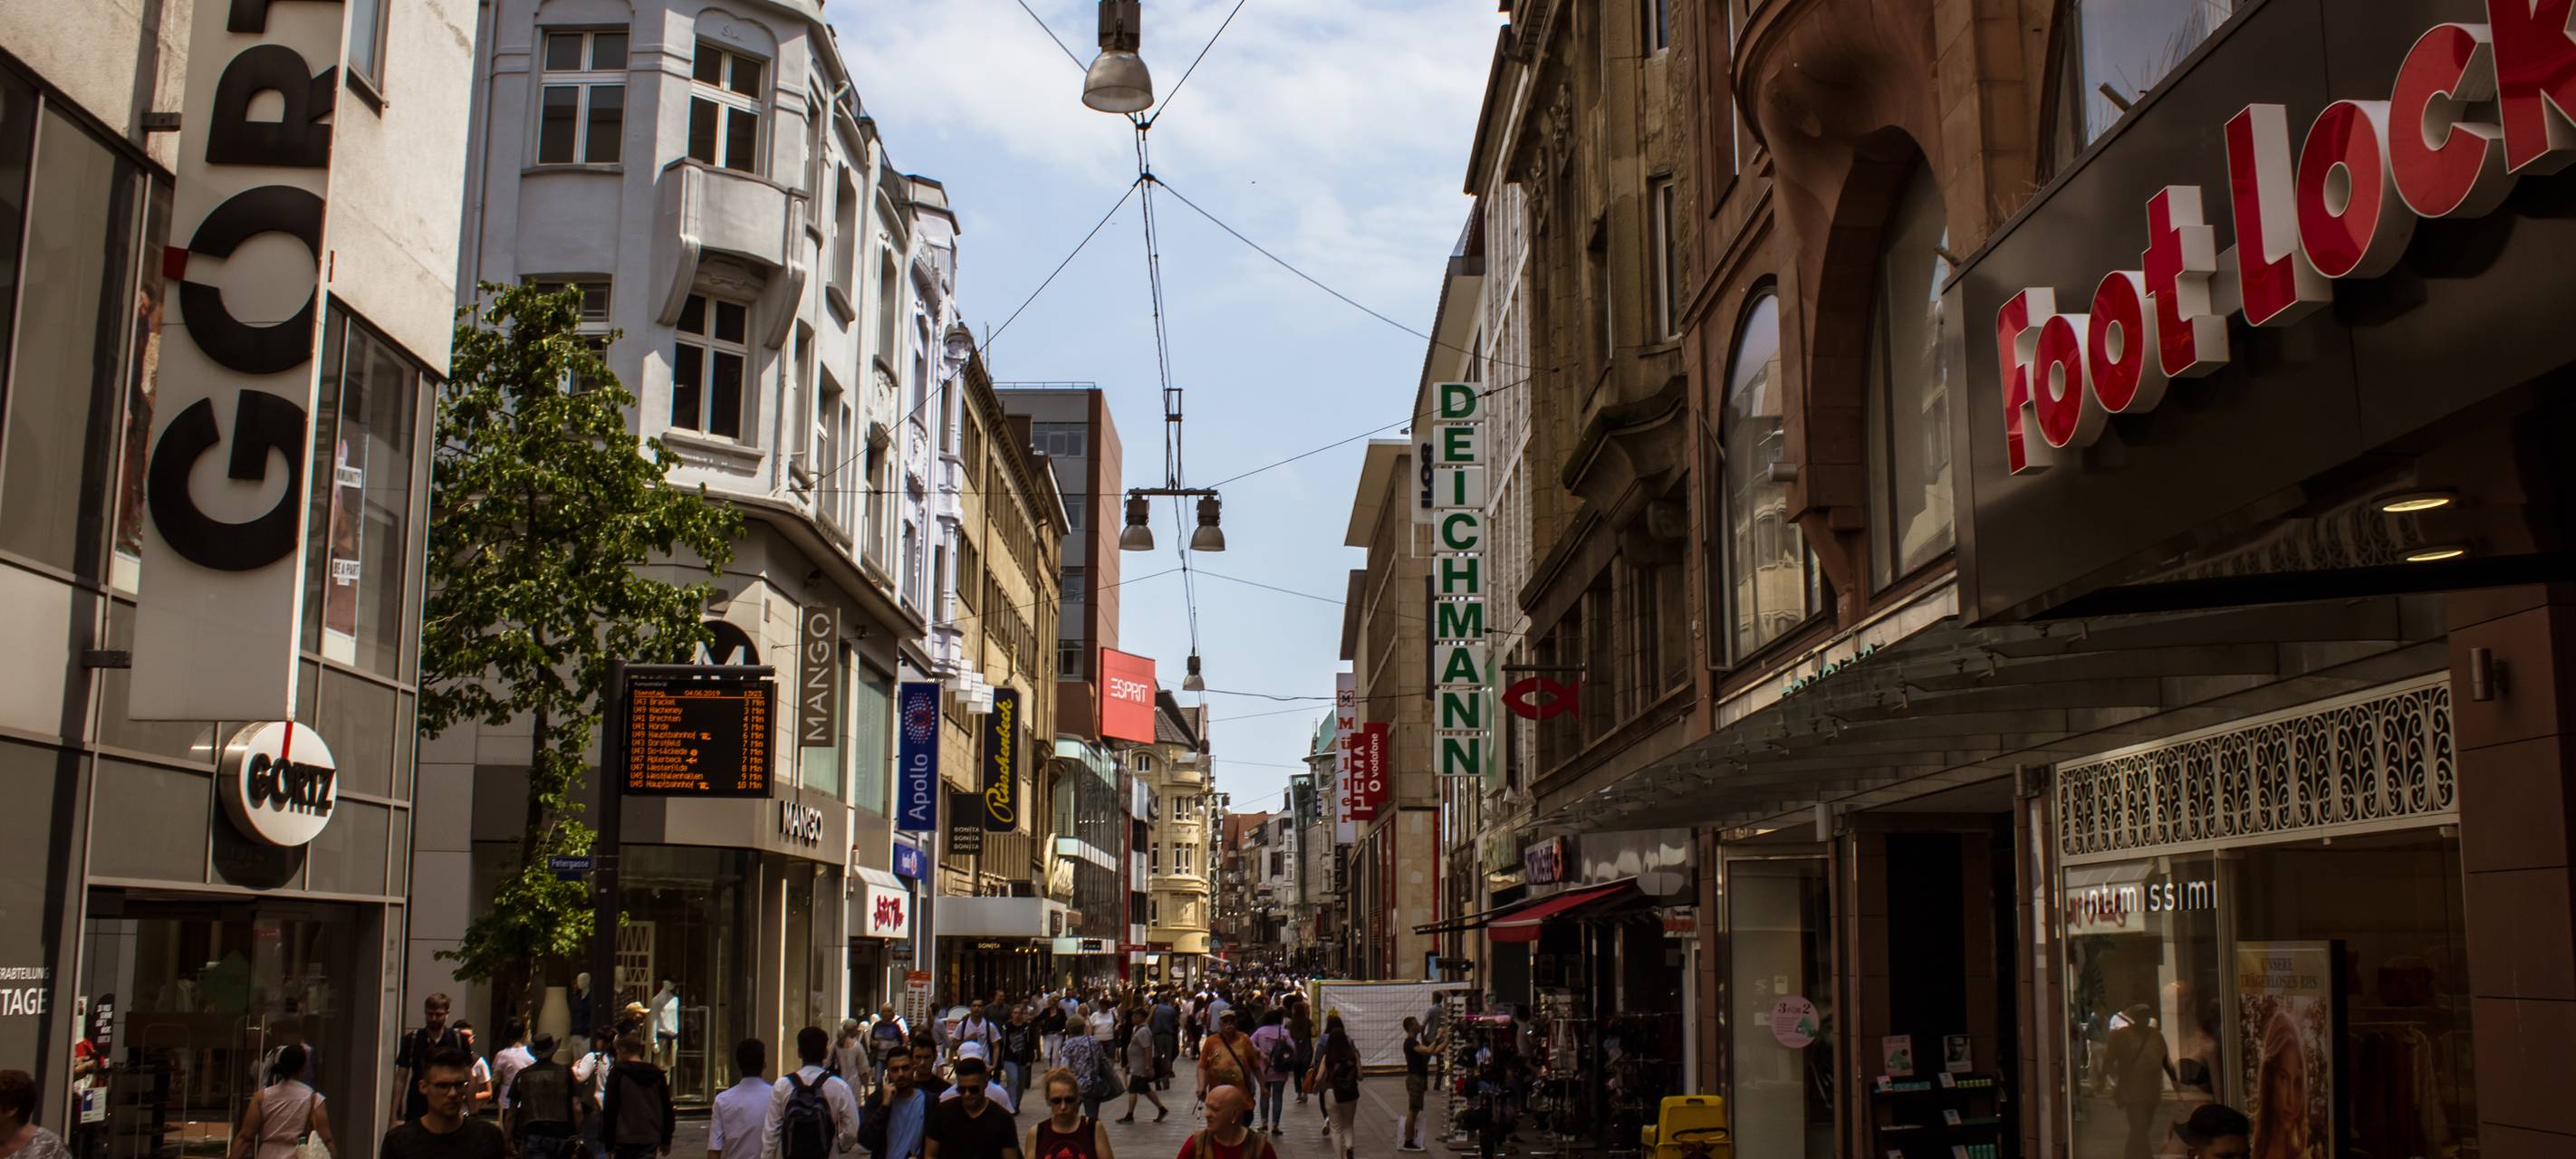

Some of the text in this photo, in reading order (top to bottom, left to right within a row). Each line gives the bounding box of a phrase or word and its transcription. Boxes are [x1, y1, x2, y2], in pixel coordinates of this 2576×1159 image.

[1996, 186, 2230, 476] Foot
[1438, 384, 1482, 774] DEICHMANN
[805, 613, 831, 741] MANGO
[1110, 677, 1148, 703] ESPRIT
[648, 731, 697, 739] Hauptbahnhof
[1370, 733, 1379, 778] vodafone
[1339, 717, 1354, 823] Müller
[646, 780, 695, 789] Hauptbahnhof
[908, 753, 931, 821] Apollo
[780, 800, 823, 842] MANGO
[954, 826, 980, 834] BONITA
[954, 843, 980, 851] BONITA
[977, 942, 1001, 950] BONITA
[0, 967, 50, 979] RABTEILUNG
[2261, 957, 2293, 972] UNSERE
[0, 988, 48, 1015] TAGE
[1778, 1001, 1787, 1014] 3
[1802, 1002, 1811, 1015] 2
